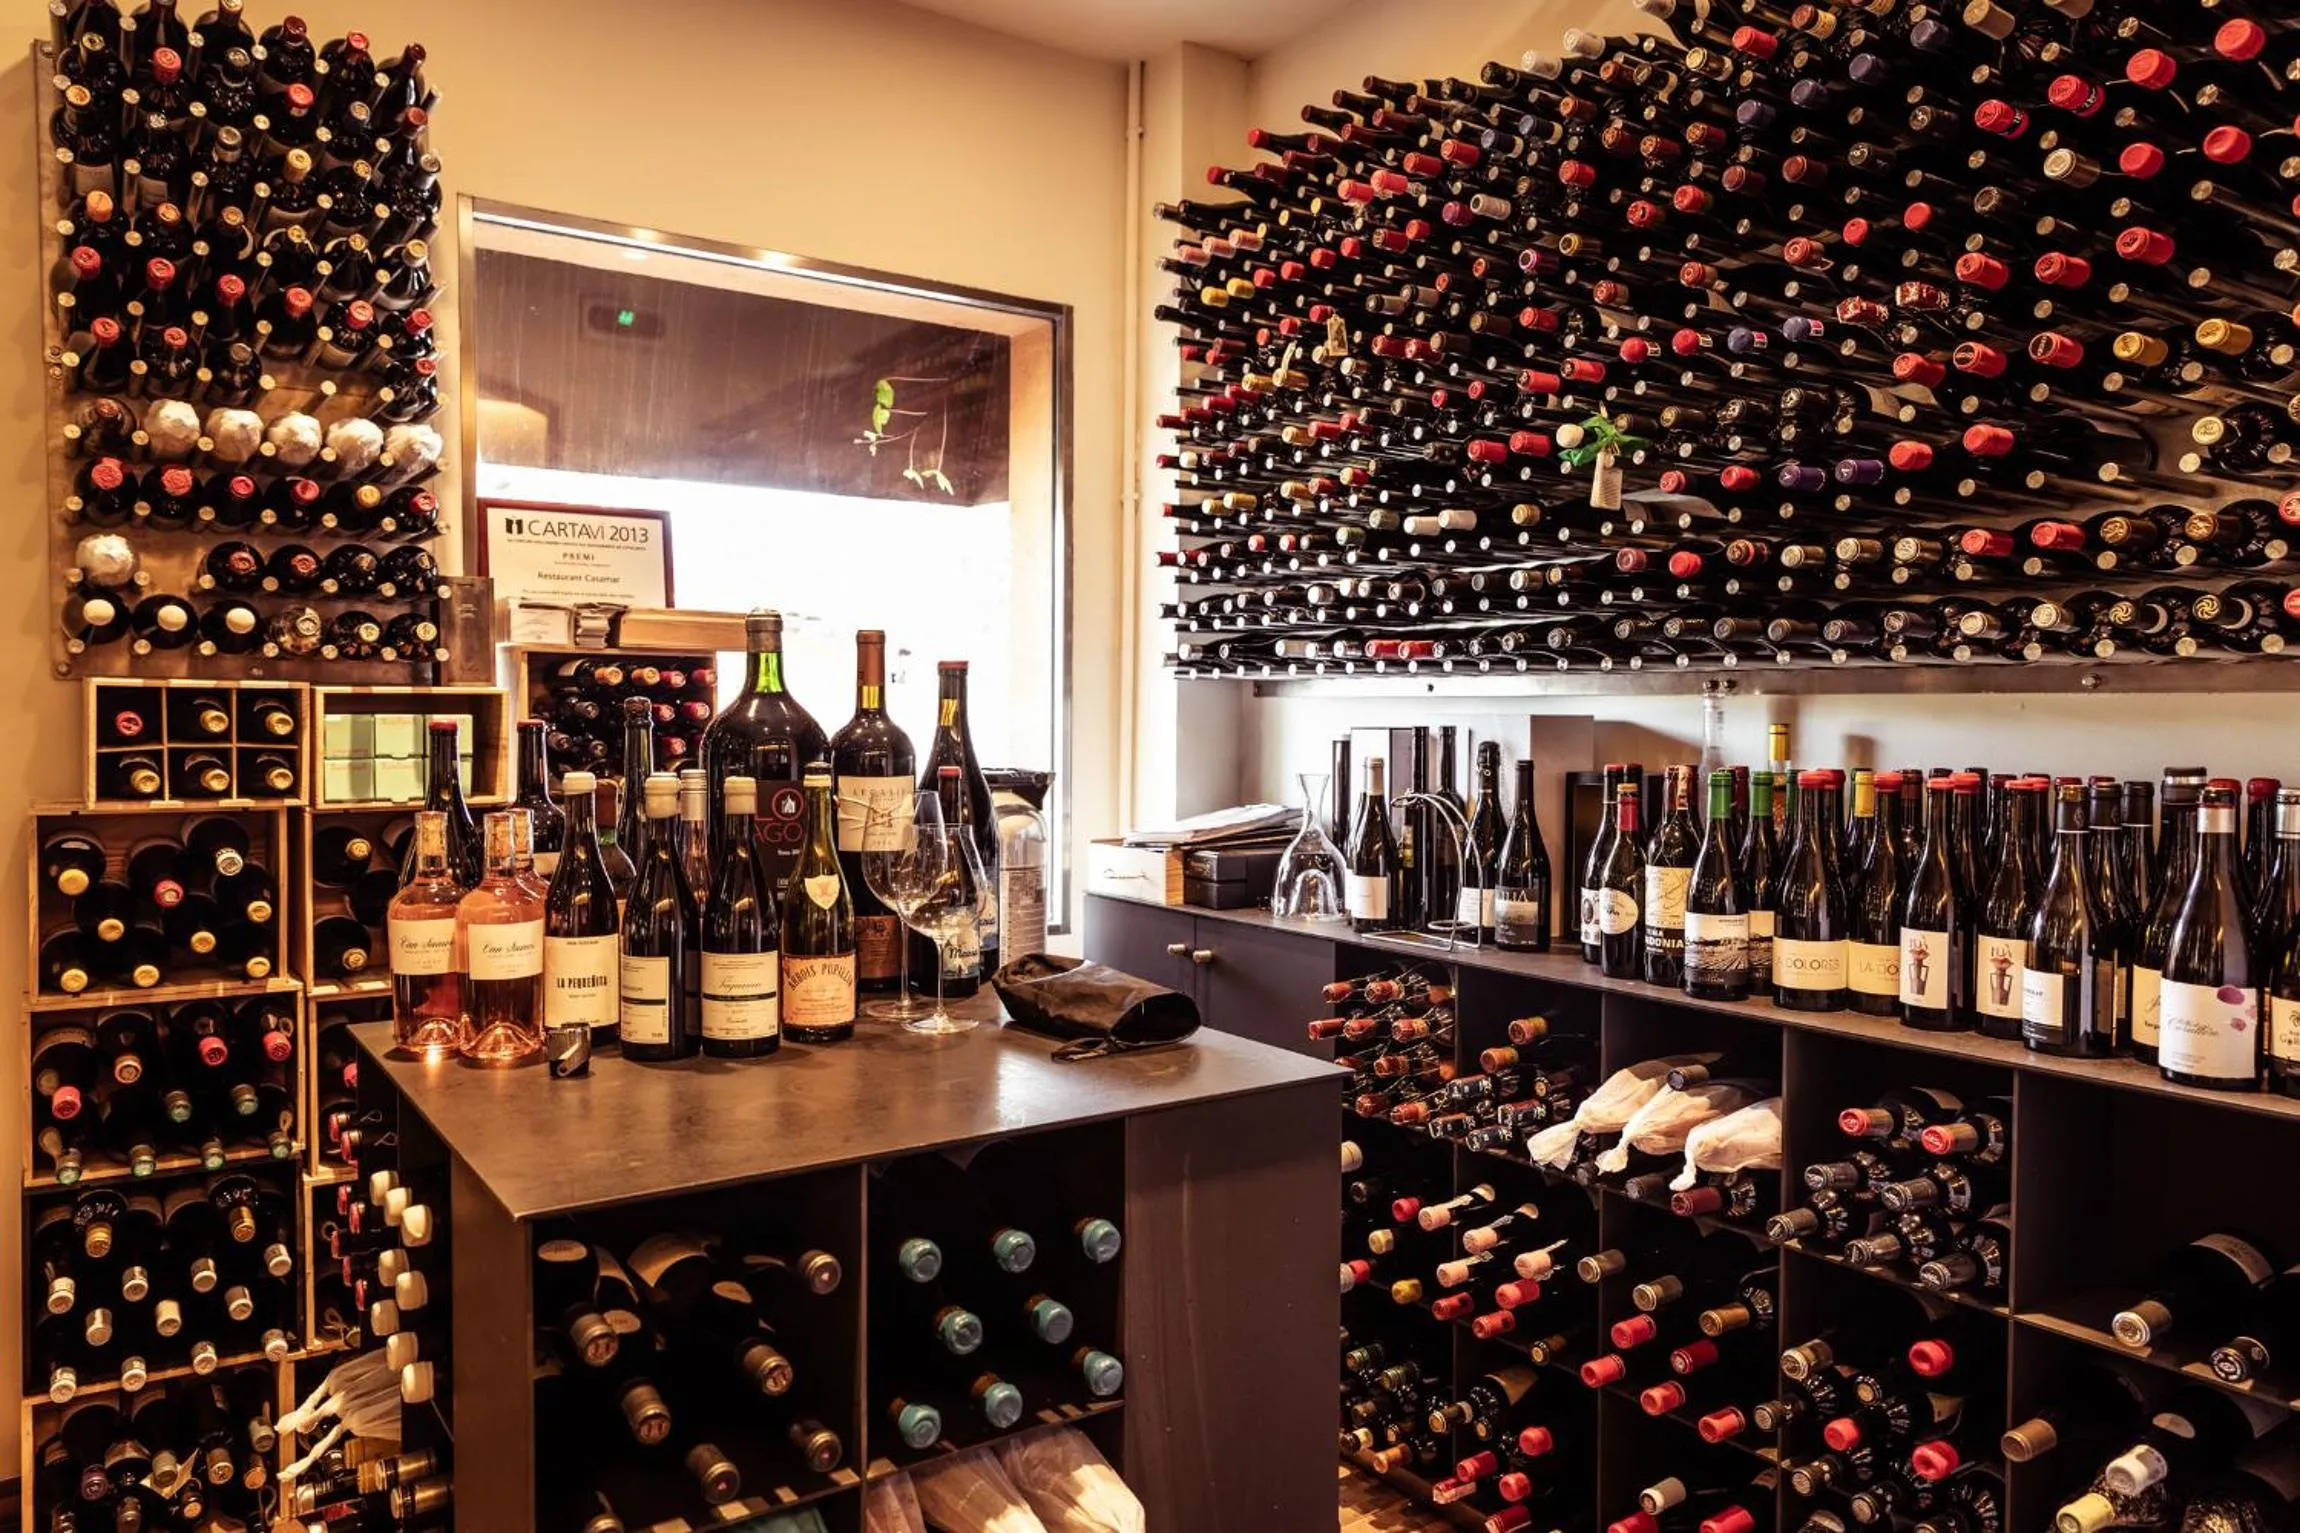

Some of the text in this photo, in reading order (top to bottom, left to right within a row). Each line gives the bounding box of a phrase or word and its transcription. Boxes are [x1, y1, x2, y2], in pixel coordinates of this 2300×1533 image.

[528, 519, 649, 544] CARTAVI 2013
[537, 571, 583, 582] Restaurant
